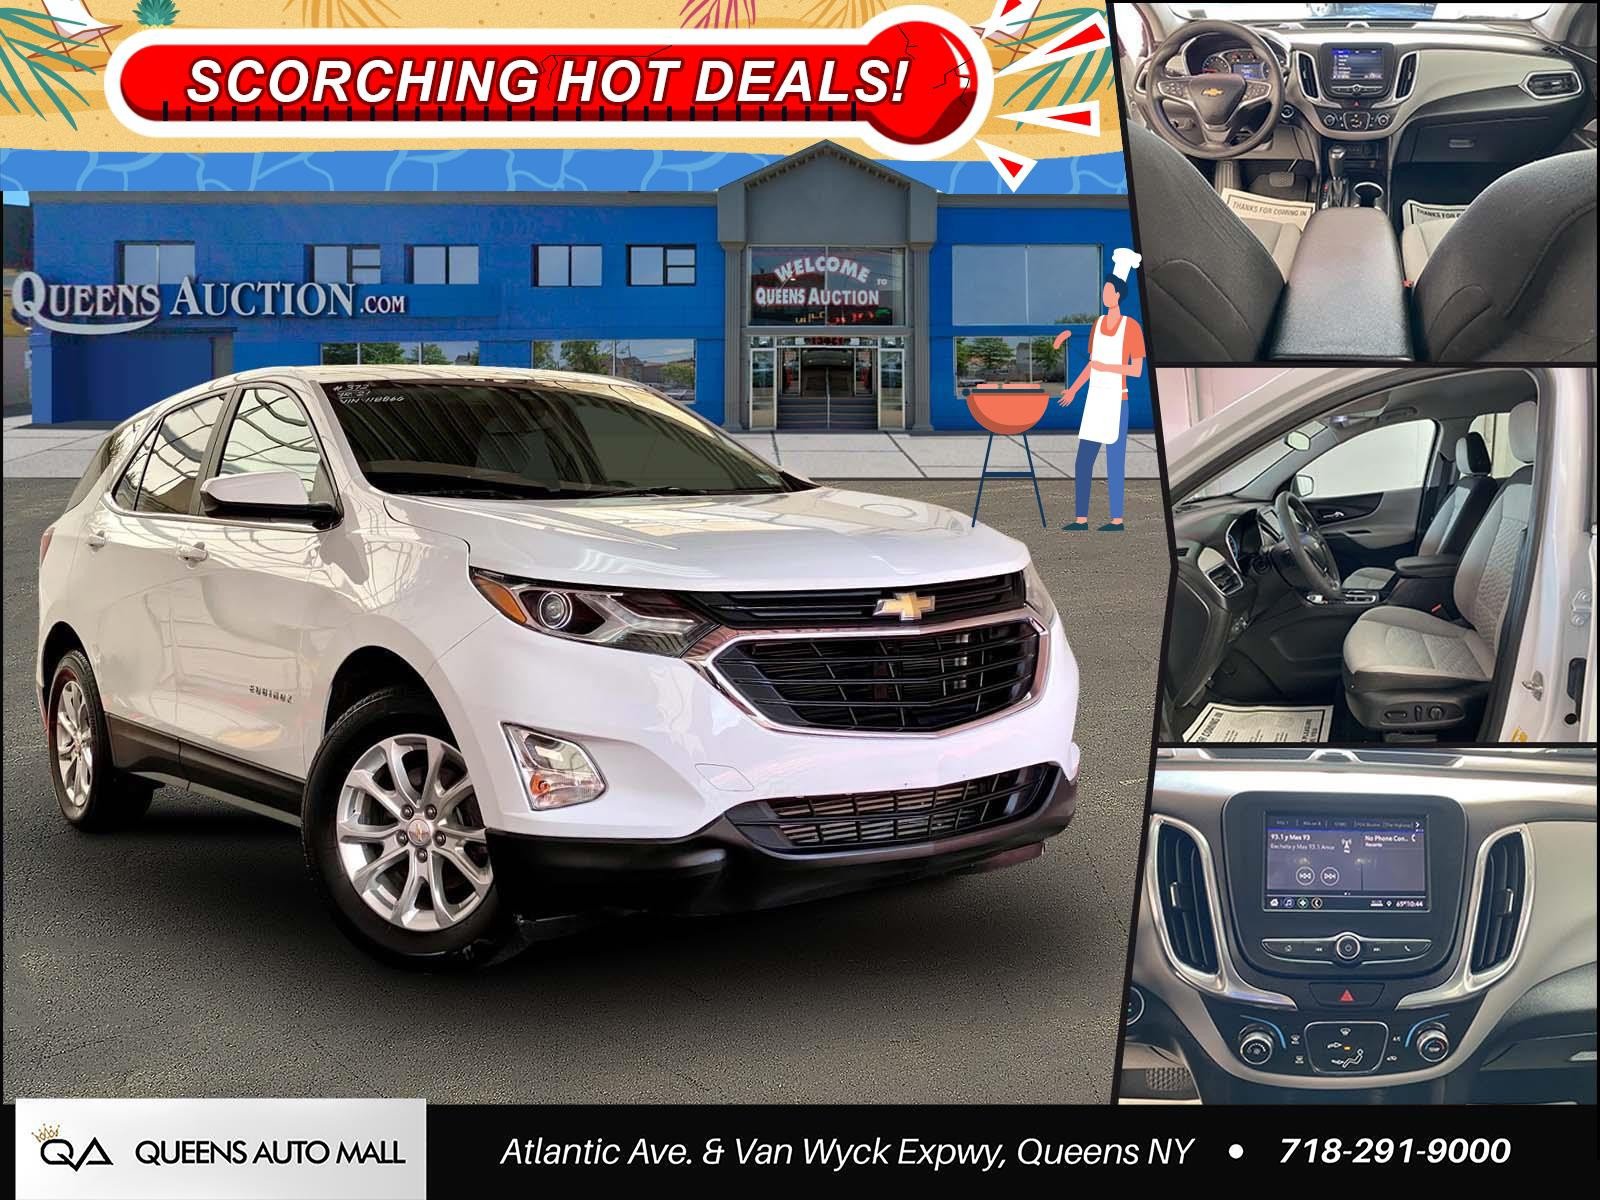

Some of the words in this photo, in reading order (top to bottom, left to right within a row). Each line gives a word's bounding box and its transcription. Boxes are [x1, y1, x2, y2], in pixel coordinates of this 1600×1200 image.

[1232, 201, 1258, 213] THANKS
[1260, 206, 1272, 214] FOR
[1273, 208, 1298, 216] COMING
[774, 256, 871, 283] WELCOME
[12, 271, 161, 335] QUEENS
[755, 287, 805, 305] QUEENS
[808, 287, 880, 305] AUCTION
